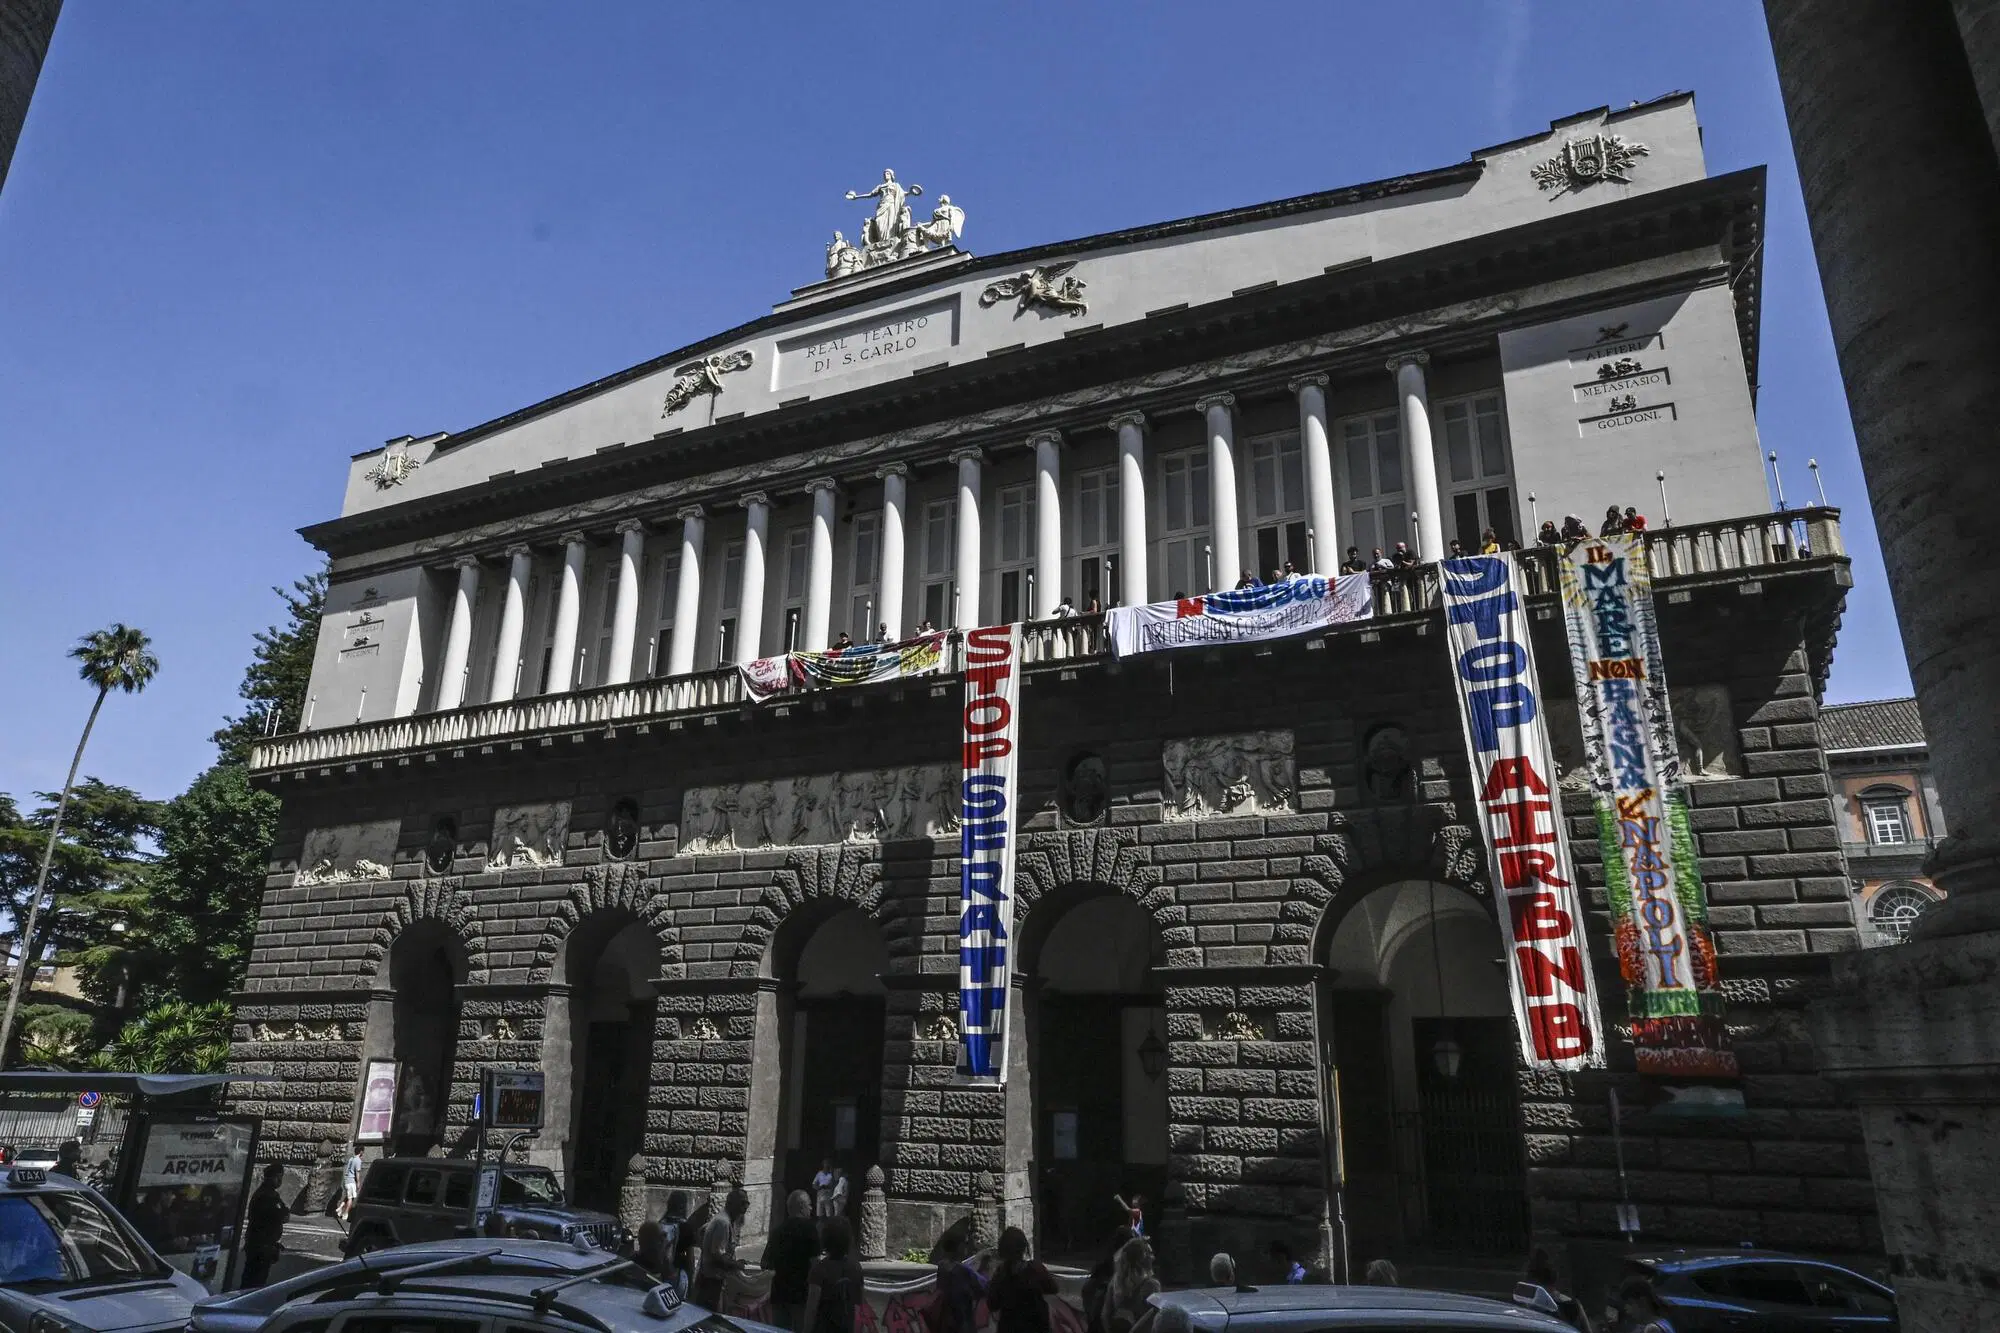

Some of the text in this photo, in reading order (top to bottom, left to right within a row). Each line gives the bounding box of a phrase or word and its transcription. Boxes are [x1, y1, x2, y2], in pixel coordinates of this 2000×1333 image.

[806, 315, 928, 359] REAL TEATRO
[814, 358, 830, 373] DI
[1442, 557, 1537, 752] STOP
[1581, 558, 1636, 658] MARE
[962, 626, 1013, 769] STOP
[1602, 680, 1651, 789] BAGNA
[956, 775, 1009, 1077] SFRATTI
[1480, 756, 1593, 1062] AIRBNB
[1617, 816, 1682, 988] NAPOLI
[19, 1171, 44, 1181] TAXI
[161, 1159, 225, 1175] AROMA
[661, 1288, 680, 1307] TAXI
